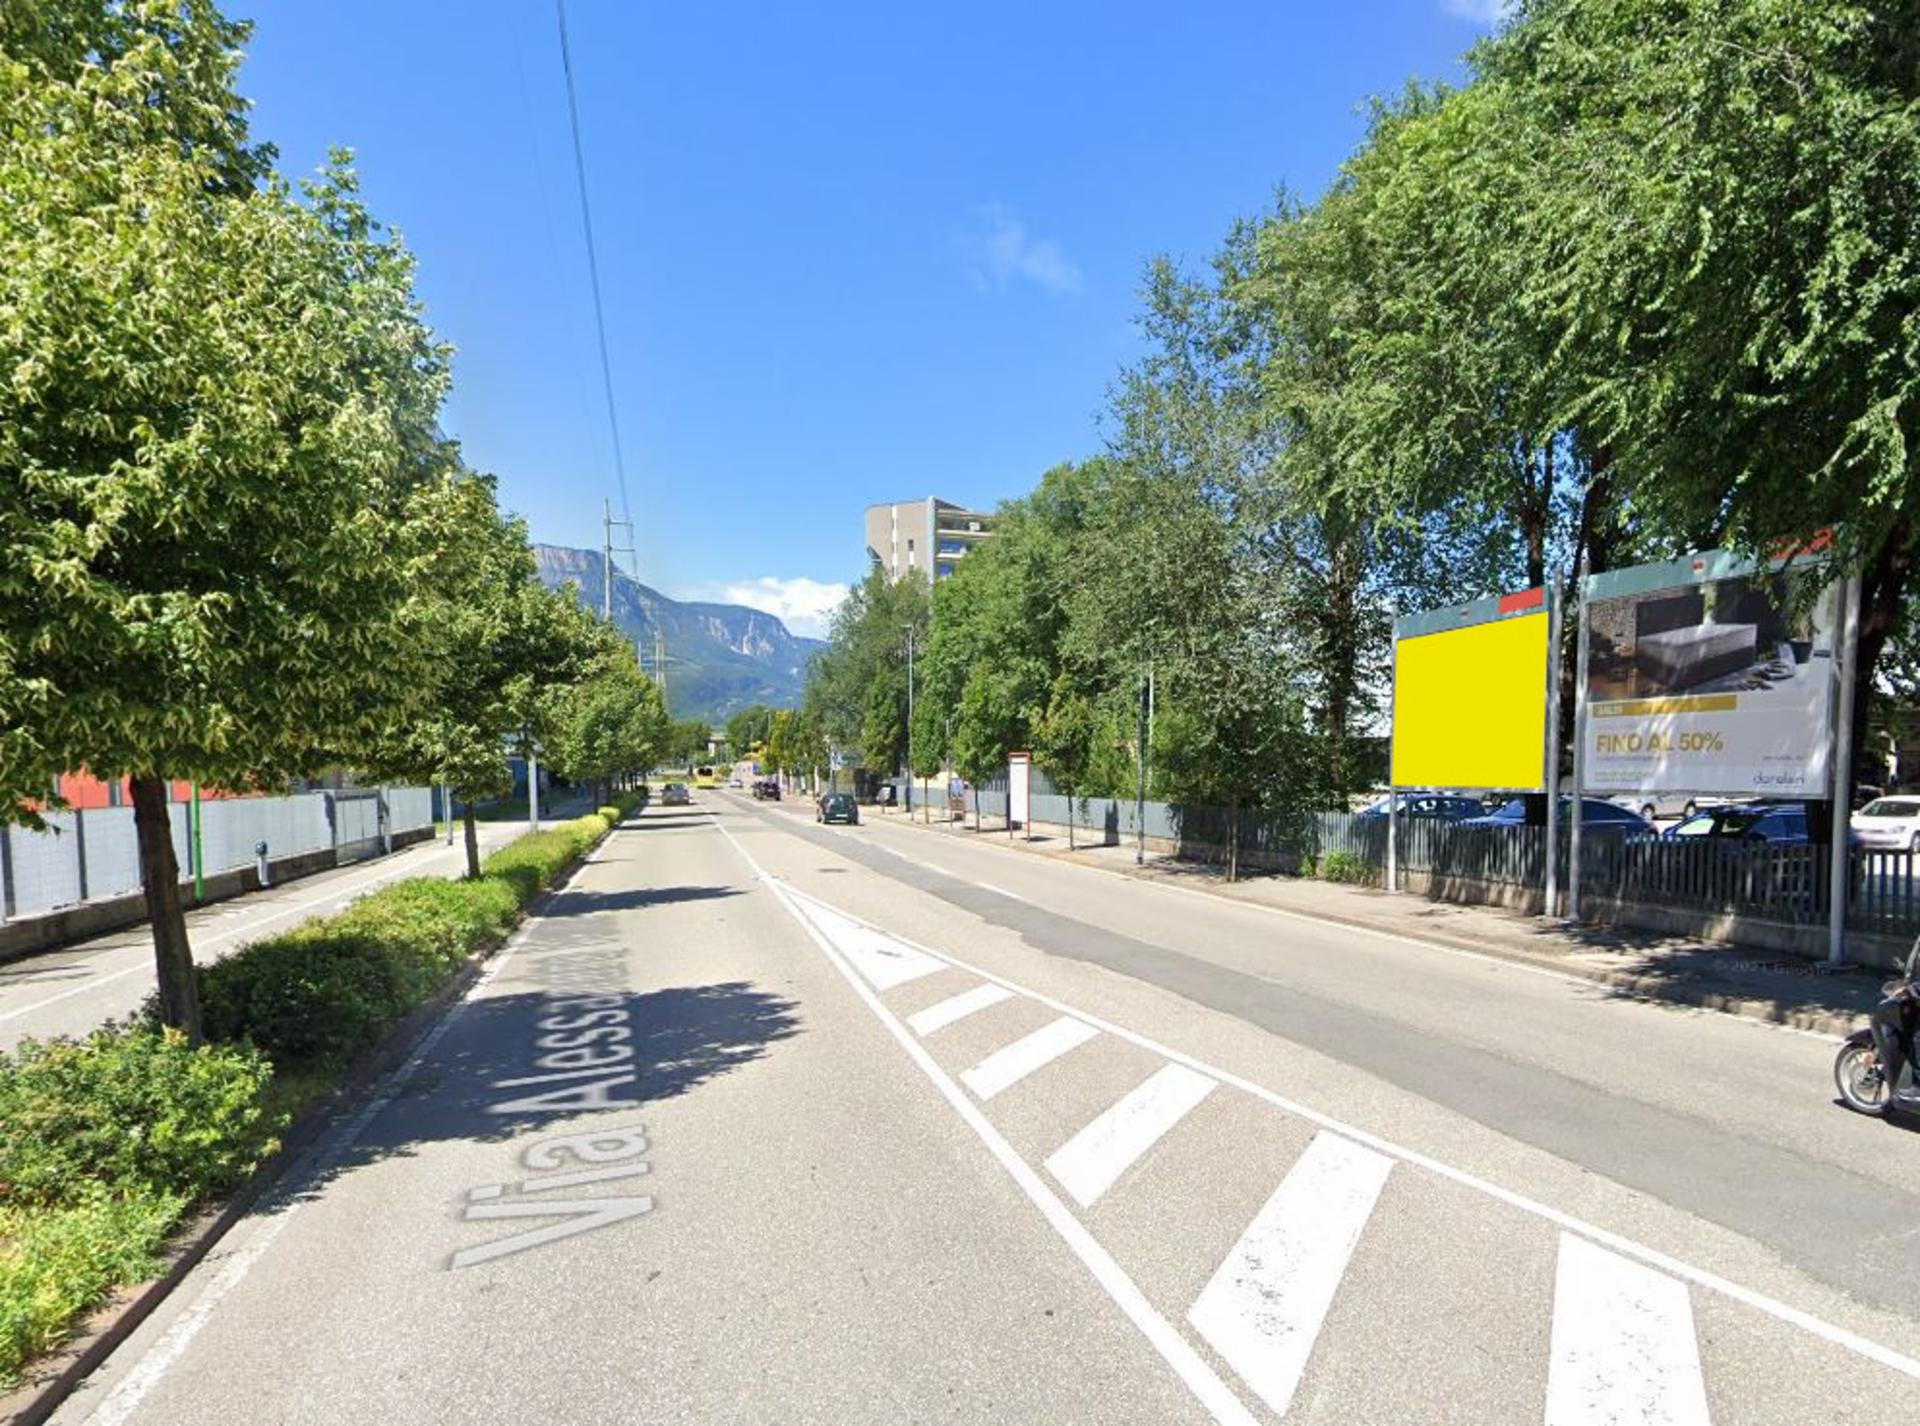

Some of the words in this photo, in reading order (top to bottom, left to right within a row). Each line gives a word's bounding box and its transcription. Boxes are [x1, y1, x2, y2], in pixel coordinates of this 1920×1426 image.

[1596, 732, 1643, 752] FINO
[1647, 731, 1674, 751] AL
[1679, 728, 1724, 752] 50%
